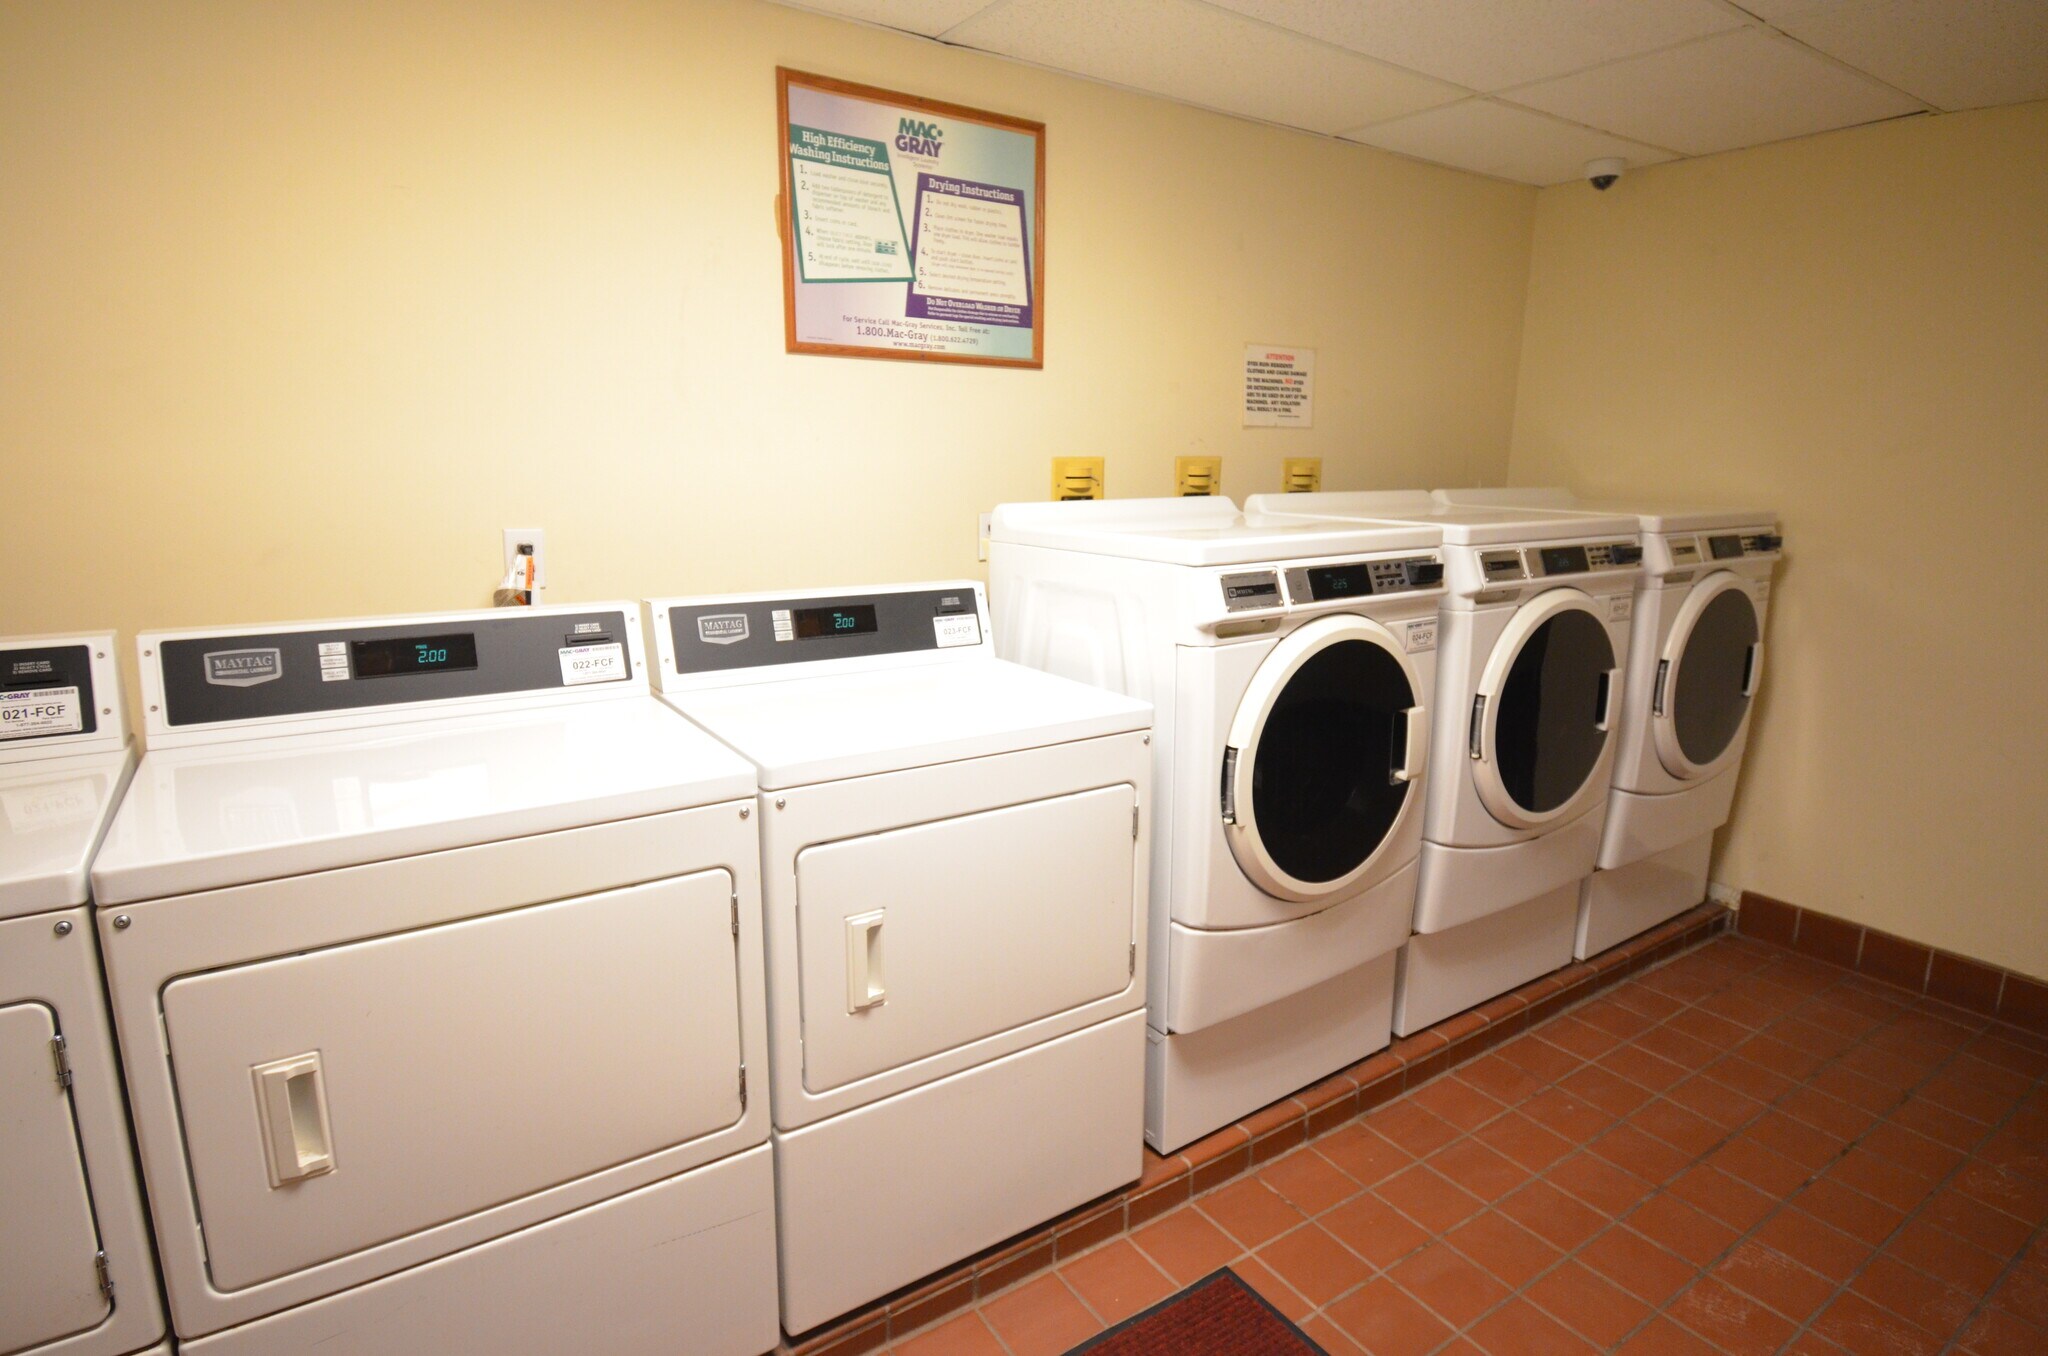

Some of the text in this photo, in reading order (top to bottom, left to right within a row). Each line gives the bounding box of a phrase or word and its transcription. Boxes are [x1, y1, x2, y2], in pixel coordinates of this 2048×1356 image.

[802, 130, 876, 157] High Efficiency
[895, 134, 943, 158] GRAY
[790, 143, 889, 171] Washing Instructions
[799, 164, 808, 175] 1.
[800, 180, 809, 191] 2.
[928, 178, 1015, 201] Drying Instructions
[926, 194, 934, 204] 1.
[803, 209, 812, 220] 3.
[925, 207, 933, 217] 2.
[805, 226, 814, 236] 4.
[923, 223, 931, 232] 3.
[808, 251, 816, 262] 5.
[920, 247, 929, 256] 4.
[919, 267, 927, 276] 5.
[918, 280, 926, 289] 6.
[843, 315, 852, 323] For
[854, 317, 876, 325] Service
[878, 318, 890, 326] Call
[892, 320, 918, 329] Mac-Gray
[958, 325, 968, 333] Toll
[969, 326, 981, 334] Free
[857, 326, 928, 343] 1.800.Mac-Gray
[893, 341, 945, 350] www.macgray.com
[704, 620, 742, 630] MAYTAG
[835, 617, 855, 628] 2.00
[943, 626, 972, 635] 023-FCF
[418, 649, 447, 663] 2.00
[214, 656, 272, 670] MAYTAG
[572, 657, 614, 670] 022-FCF
[2, 705, 66, 720] 021-FCF
